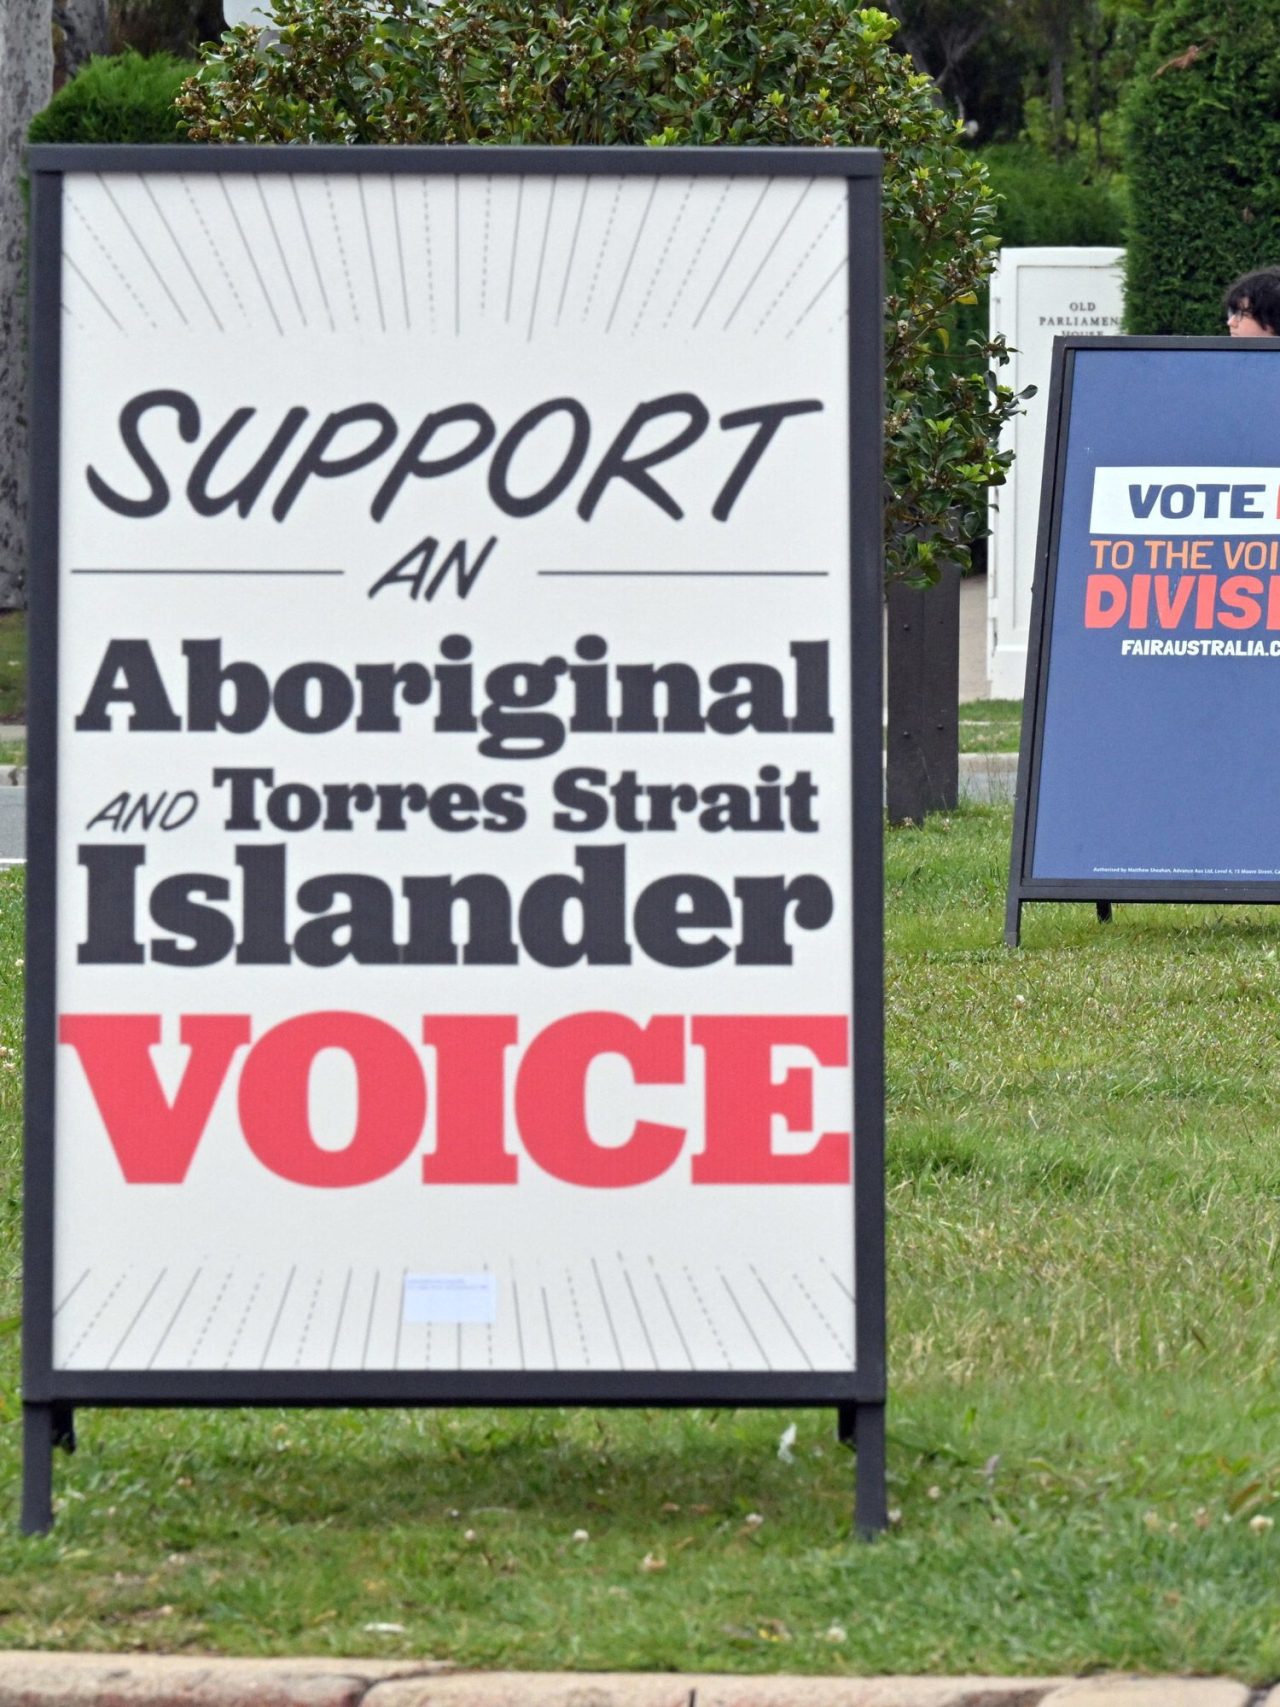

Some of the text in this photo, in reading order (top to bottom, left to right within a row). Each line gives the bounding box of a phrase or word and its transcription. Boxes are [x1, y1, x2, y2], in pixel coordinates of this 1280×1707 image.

[1039, 316, 1120, 326] PARLIAMEN
[1069, 302, 1096, 312] OLD
[86, 389, 824, 523] SUPPORT
[1128, 484, 1266, 519] VOTE
[367, 536, 497, 601] AN
[1090, 540, 1134, 569] TO
[1144, 540, 1214, 570] THE
[75, 634, 835, 759] Aboriginal
[86, 764, 819, 833] AND Torres Strait
[76, 842, 834, 968] Islander
[58, 1010, 852, 1189] VOICE
